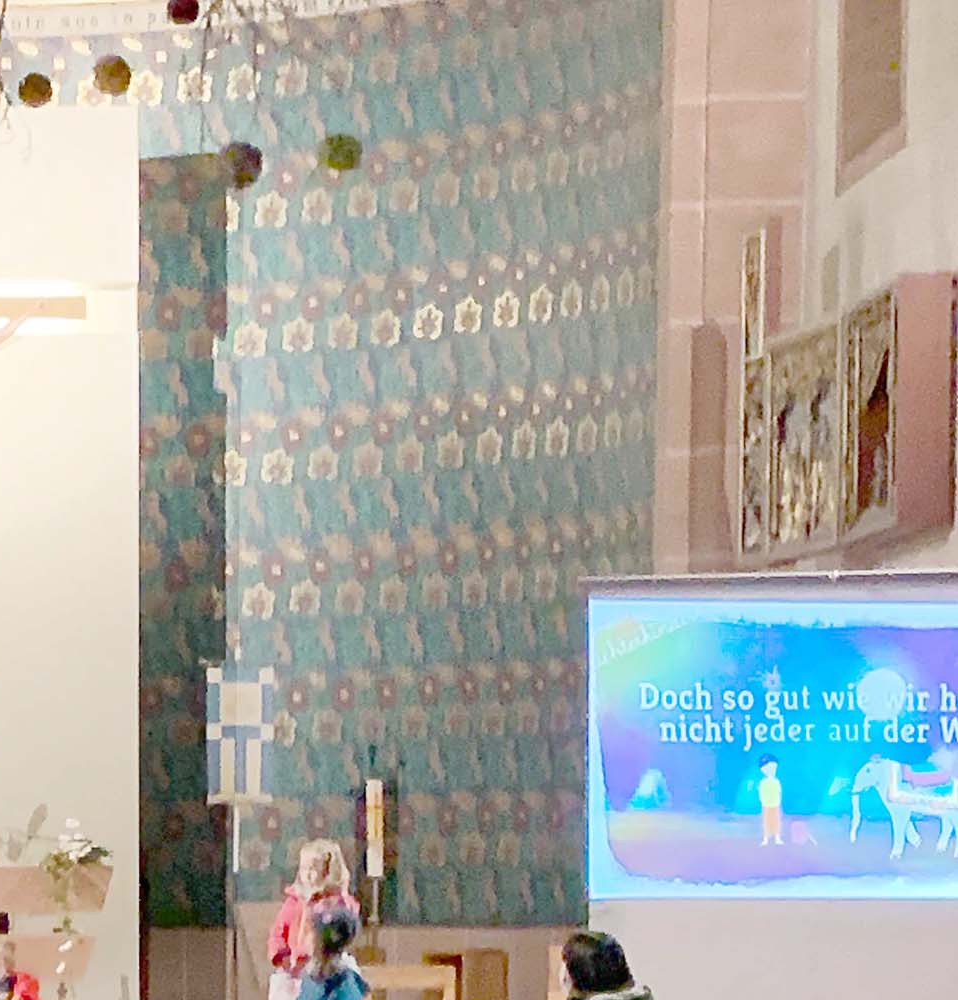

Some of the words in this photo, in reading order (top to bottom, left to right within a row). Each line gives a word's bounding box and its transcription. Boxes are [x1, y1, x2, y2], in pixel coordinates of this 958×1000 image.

[638, 682, 713, 711] Doch
[722, 688, 755, 711] so
[764, 684, 811, 719] gut
[658, 714, 734, 743] nicht
[743, 715, 815, 752] jeder
[882, 715, 930, 743] der
